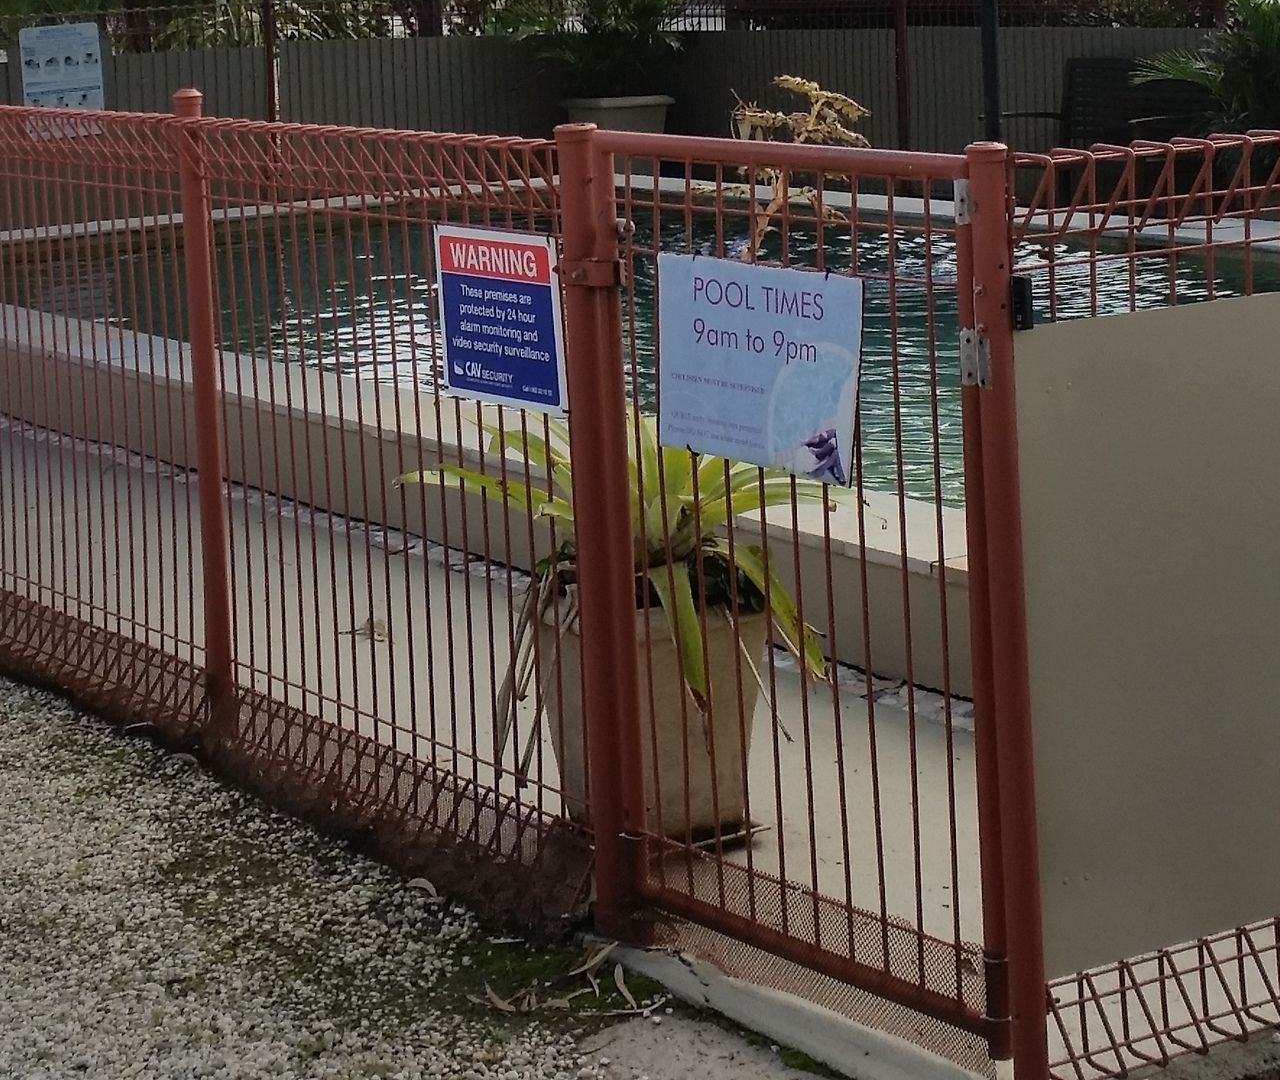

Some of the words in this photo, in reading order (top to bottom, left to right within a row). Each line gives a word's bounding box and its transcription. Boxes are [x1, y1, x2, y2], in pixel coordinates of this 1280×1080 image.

[449, 242, 537, 278] WARNING
[460, 283, 483, 299] These
[484, 289, 518, 303] premises
[519, 294, 532, 305] are
[693, 276, 755, 310] POOL
[761, 286, 825, 321] TIMES
[459, 303, 495, 318] protected
[496, 306, 506, 322] by
[507, 308, 517, 321] 24
[518, 309, 536, 324] hour
[459, 318, 481, 329] alarm
[481, 323, 522, 343] monitoring
[523, 329, 539, 342] and
[693, 318, 739, 350] 9am
[746, 328, 765, 354] to
[772, 330, 817, 365] 9pm
[452, 334, 473, 350] video
[473, 340, 503, 357] security
[504, 344, 551, 362] surveillance
[465, 361, 482, 378] CAV
[482, 369, 513, 383] SECURITY
